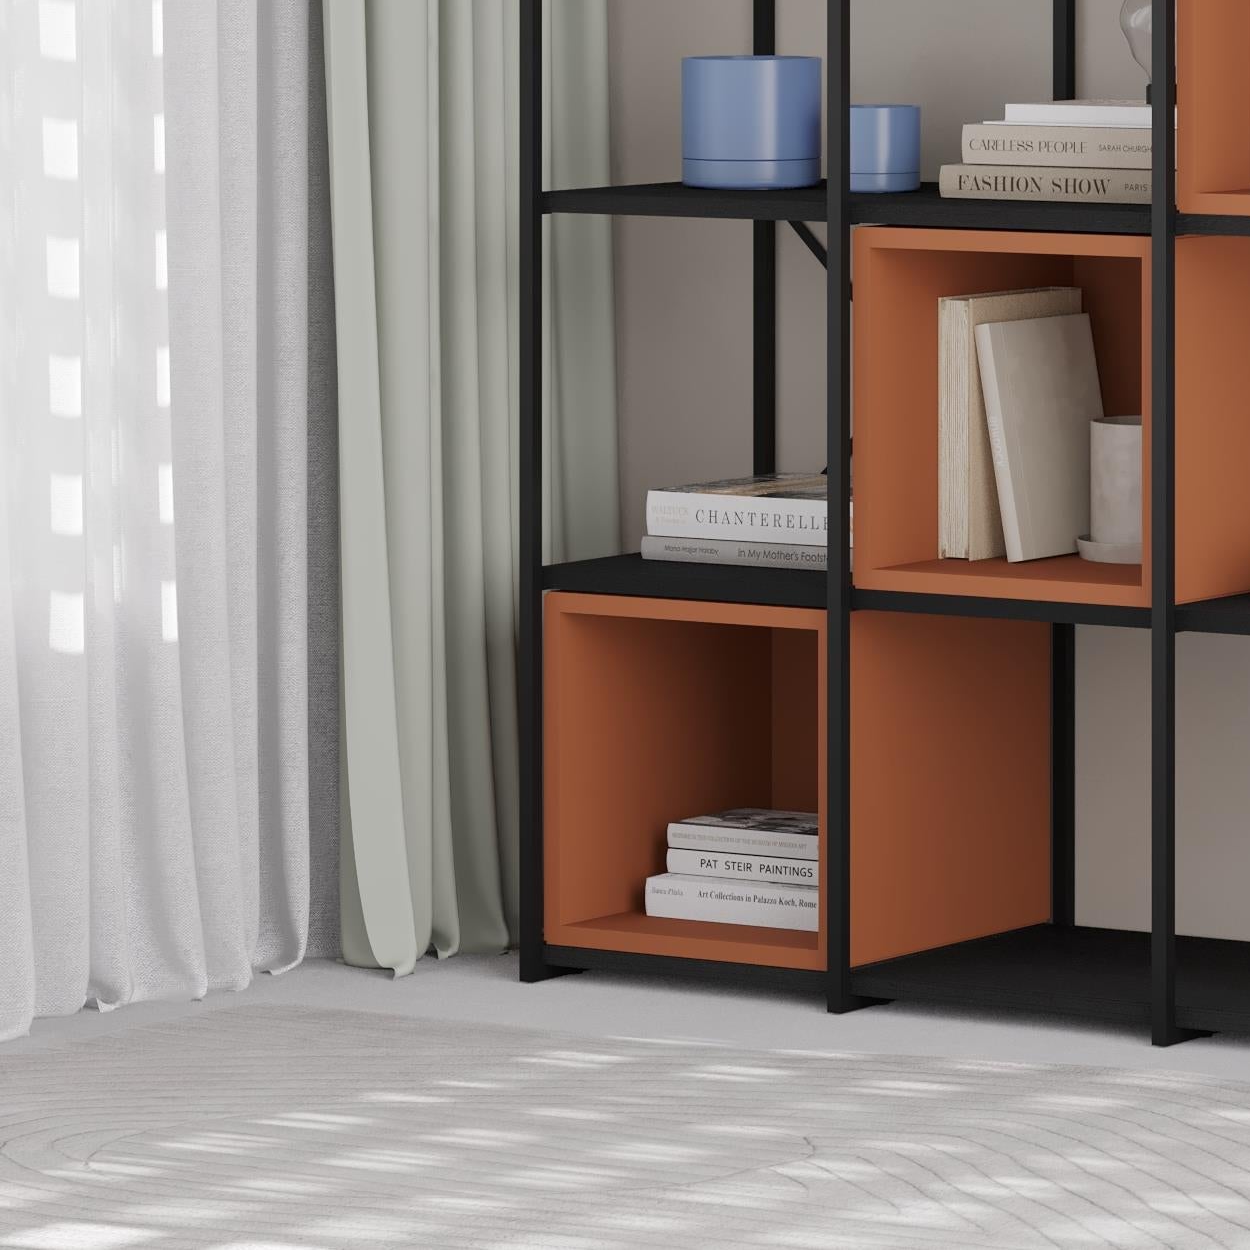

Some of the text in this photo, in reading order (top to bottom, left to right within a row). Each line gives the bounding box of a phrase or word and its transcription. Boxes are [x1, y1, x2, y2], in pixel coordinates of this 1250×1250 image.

[969, 138, 1034, 152] CARELESS
[1038, 141, 1089, 154] PEOPLE
[1098, 144, 1121, 152] SARAH
[958, 174, 1148, 195] FASHION SHOW PARIS
[749, 549, 760, 560] My
[763, 550, 799, 561] Mother's
[700, 858, 813, 878] PAT STEIR PAINTINGS
[698, 890, 817, 909] Art Collections in Palazzo Koch, Rome
